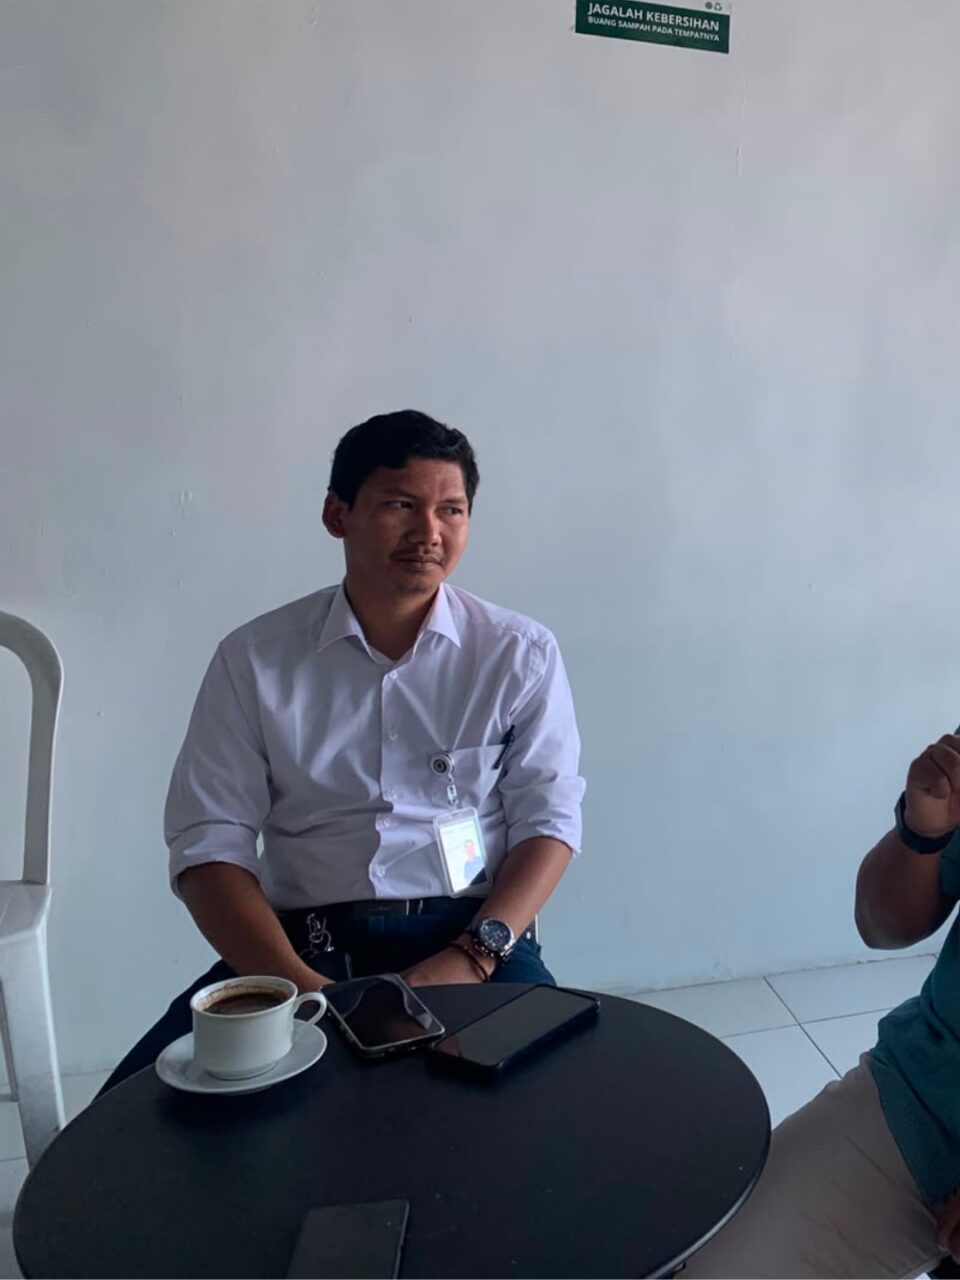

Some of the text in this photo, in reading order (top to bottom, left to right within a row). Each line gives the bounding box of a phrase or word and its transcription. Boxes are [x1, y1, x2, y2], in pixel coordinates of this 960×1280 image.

[587, 2, 720, 32] JAGALAH KEBERSIHAN
[588, 16, 720, 42] BUANG SAMPAH PADA TEMPATNYA
